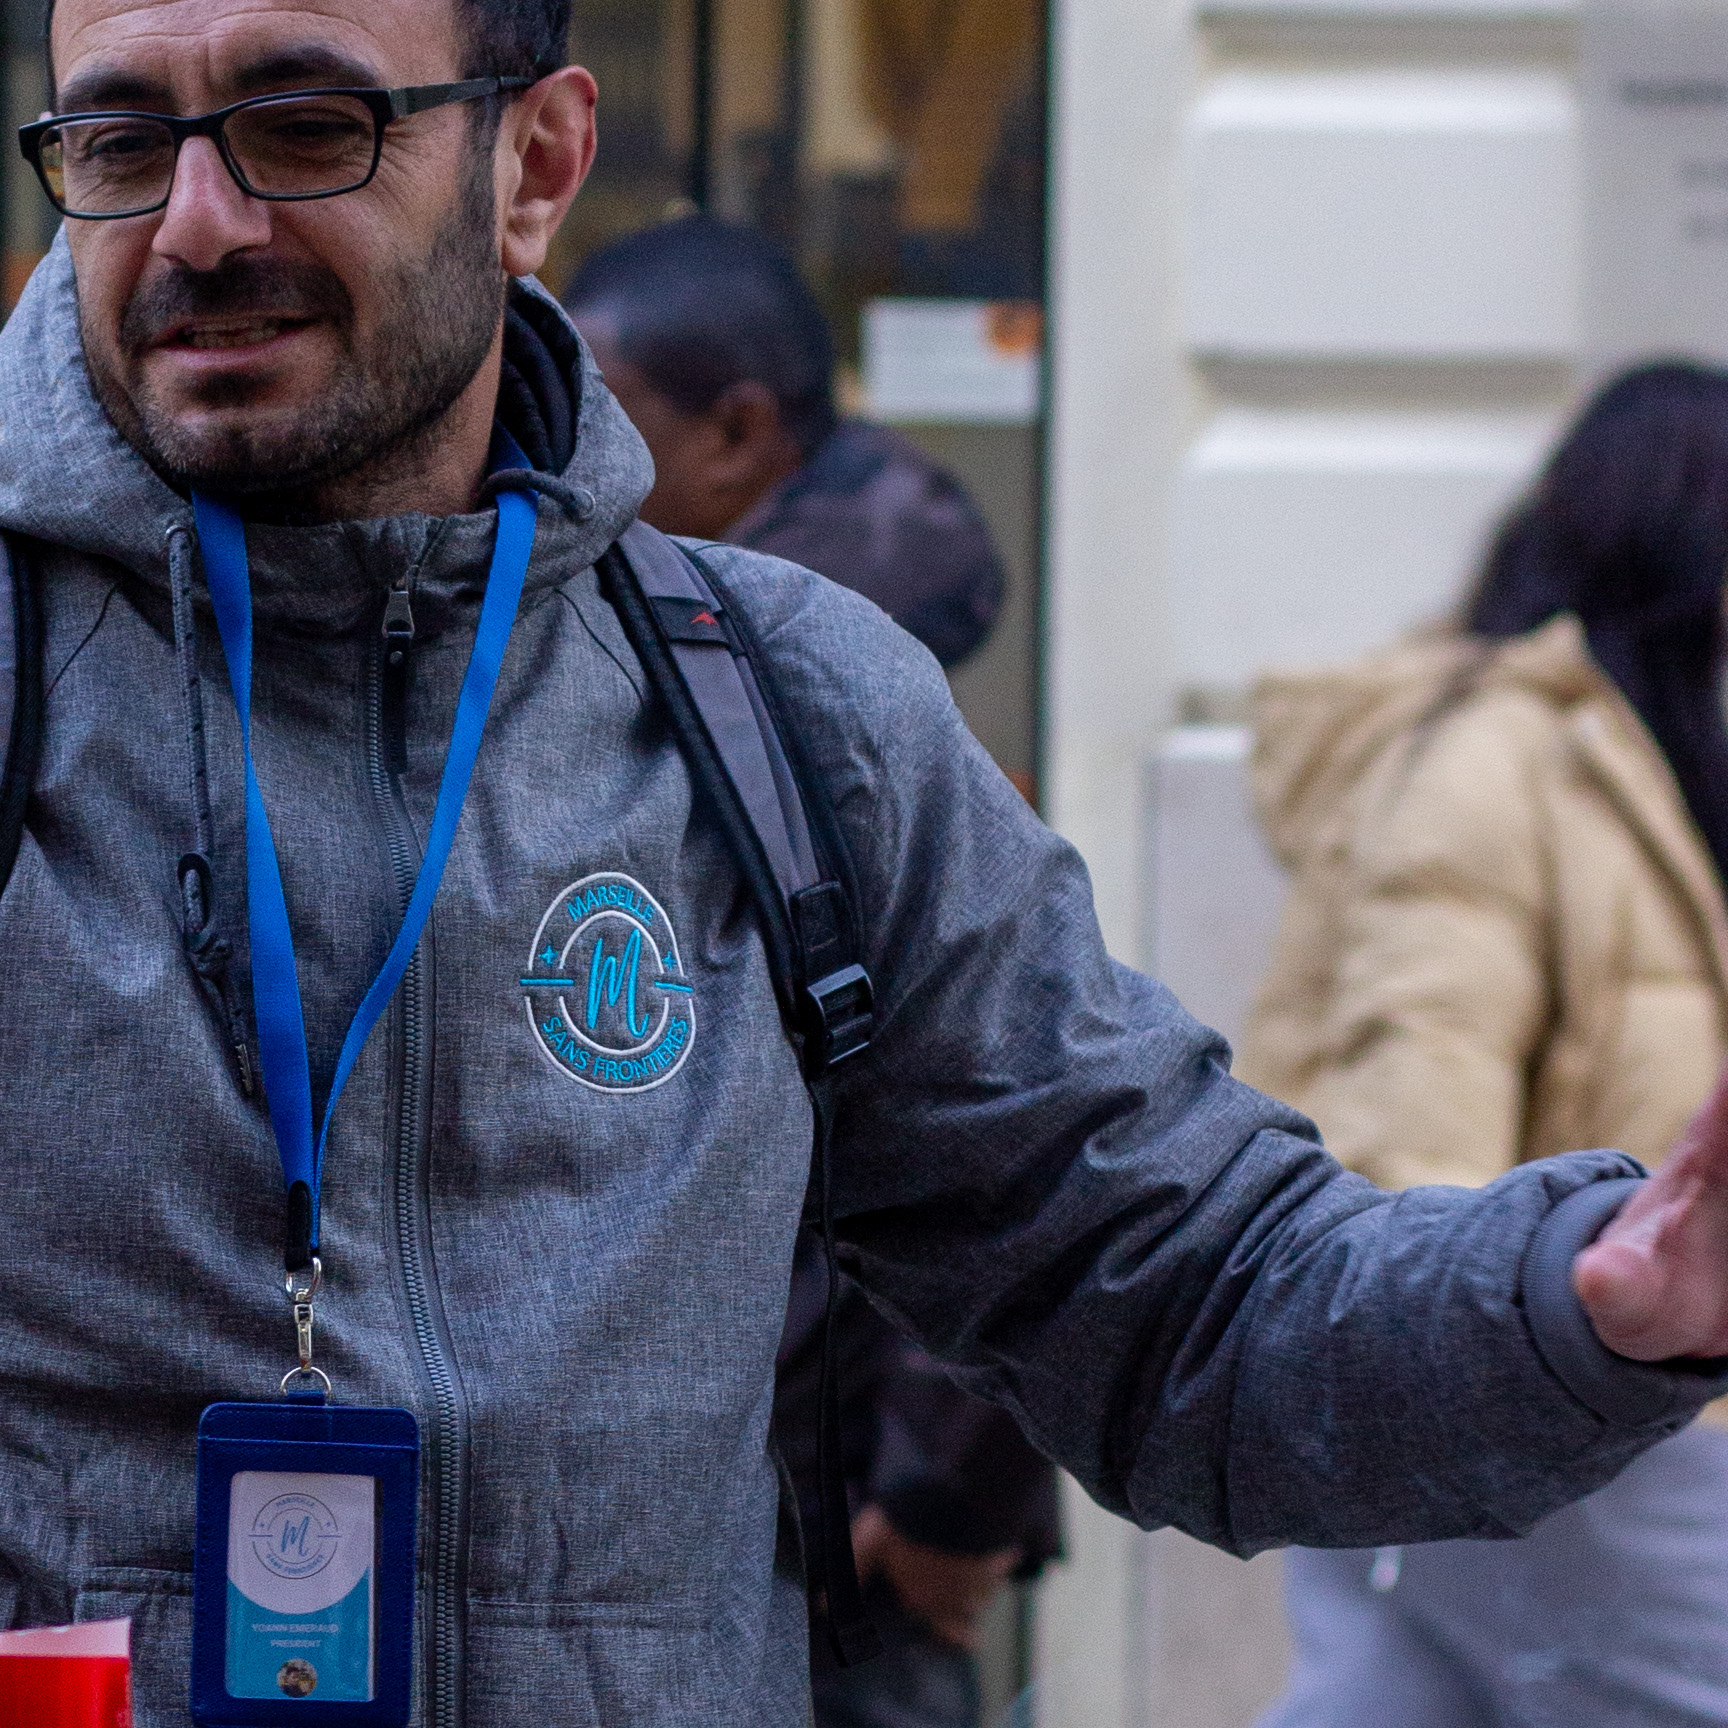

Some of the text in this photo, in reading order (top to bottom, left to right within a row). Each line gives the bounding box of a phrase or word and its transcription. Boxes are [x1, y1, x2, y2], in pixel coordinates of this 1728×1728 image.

[567, 884, 655, 927] MARSEILLE
[542, 1016, 688, 1081] SANS FRONTIERES
